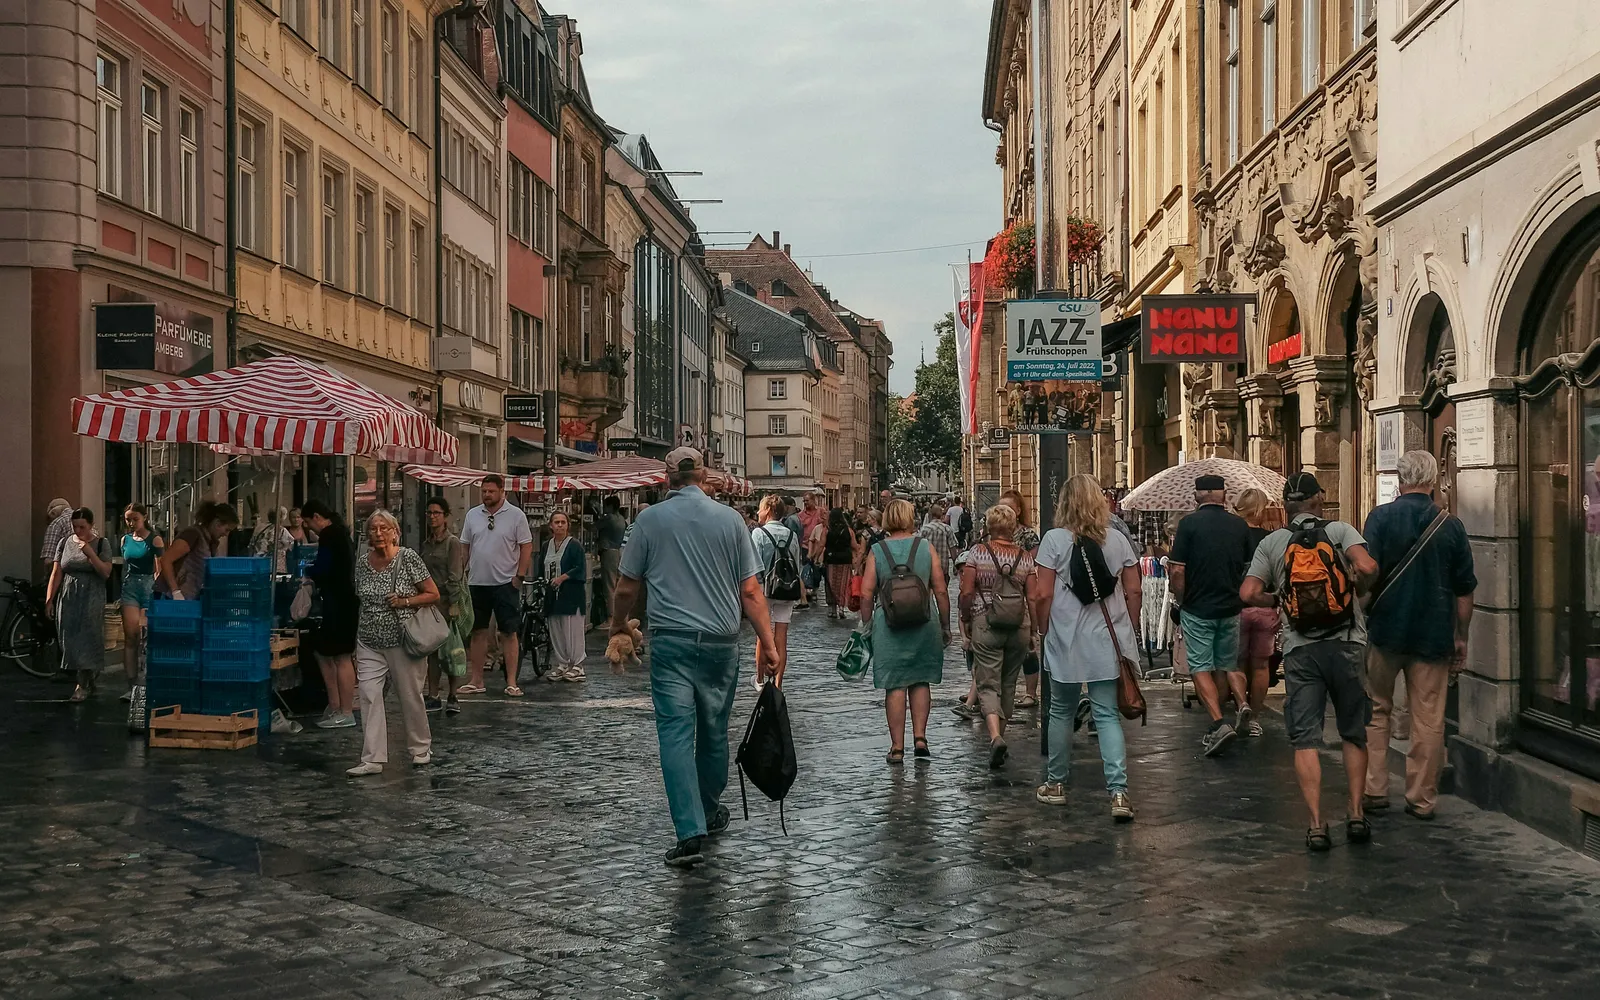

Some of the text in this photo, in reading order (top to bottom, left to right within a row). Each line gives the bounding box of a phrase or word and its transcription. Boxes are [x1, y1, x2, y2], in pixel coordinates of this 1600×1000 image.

[1058, 304, 1082, 312] CSU
[156, 314, 212, 349] PARFÜMERIE
[1016, 318, 1094, 354] JAZZ-
[156, 342, 184, 358] AMBERG
[1026, 346, 1088, 356] Frühschoppen
[1026, 362, 1056, 370] Sonntag,
[1067, 362, 1078, 370] Juli
[460, 380, 486, 410] ONLY
